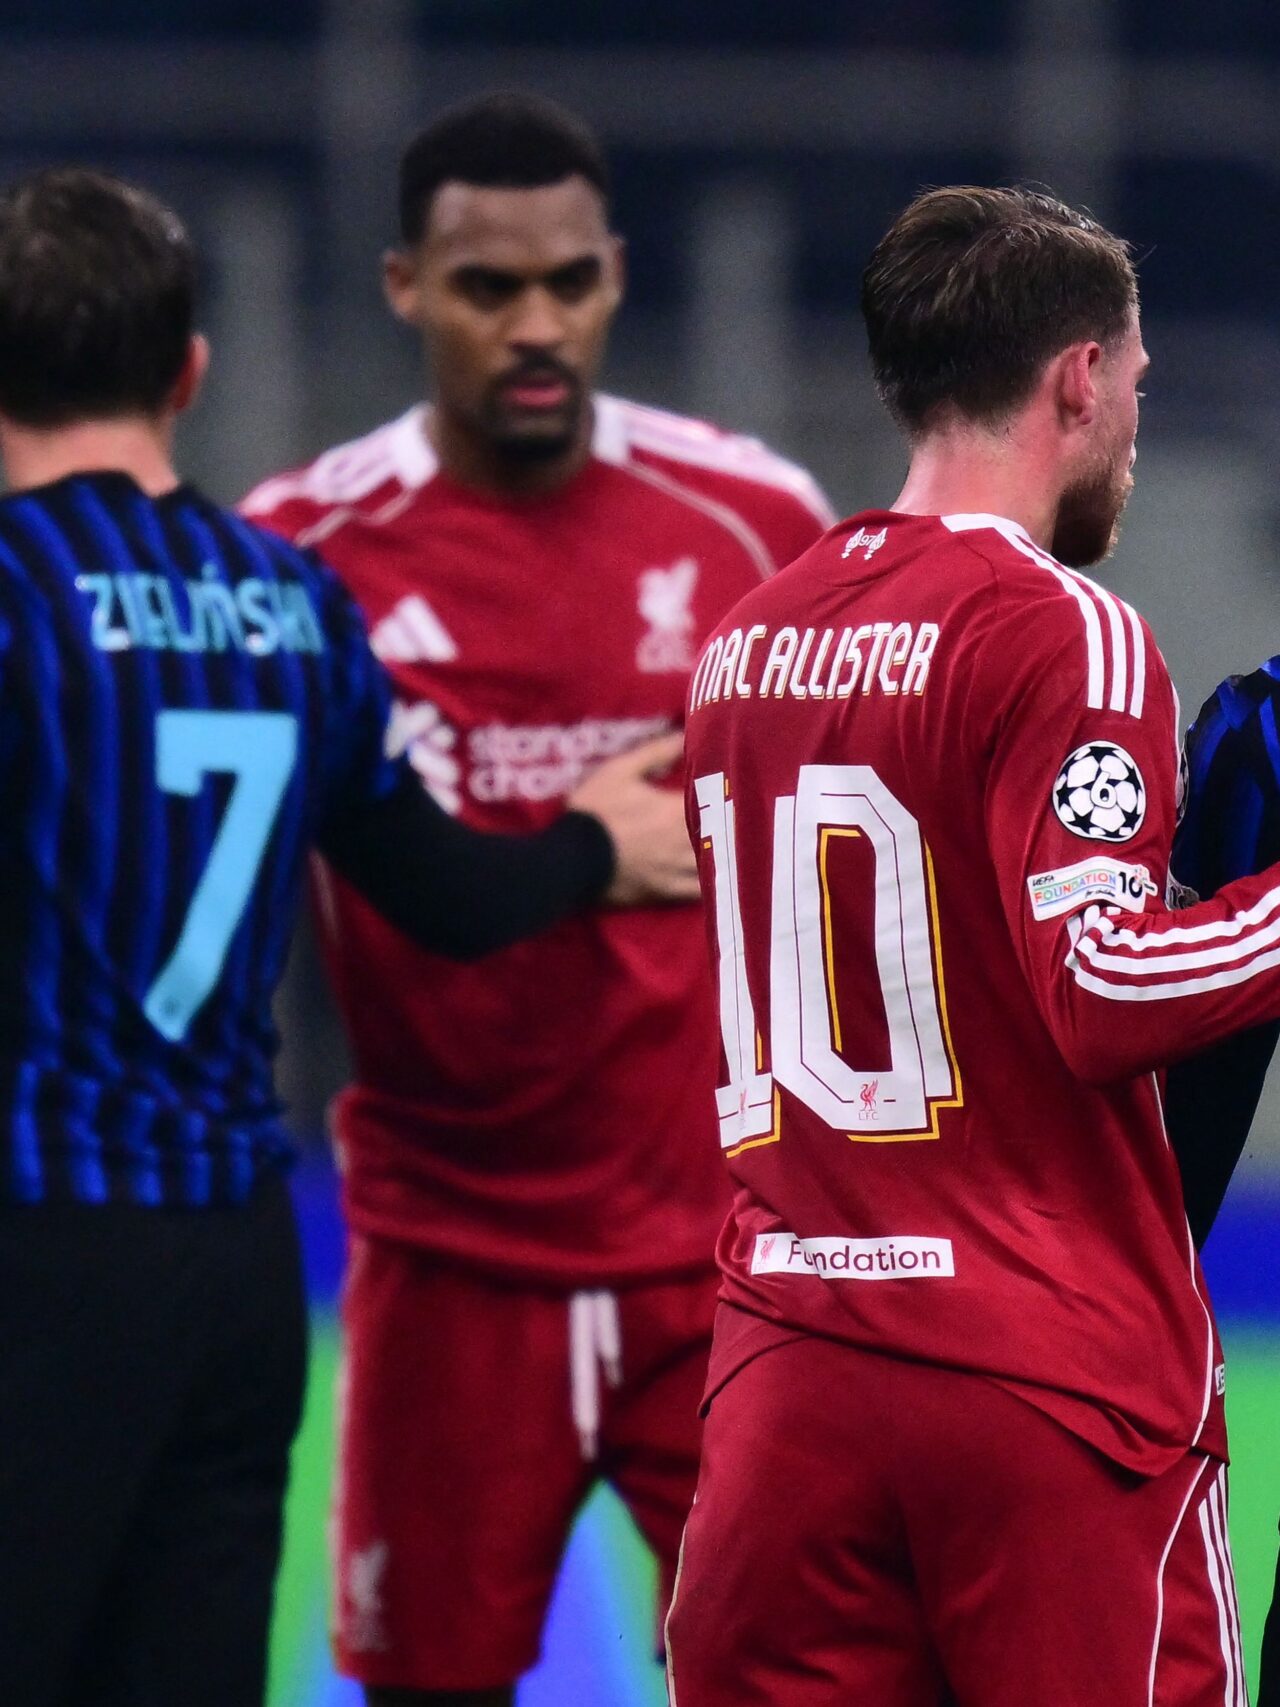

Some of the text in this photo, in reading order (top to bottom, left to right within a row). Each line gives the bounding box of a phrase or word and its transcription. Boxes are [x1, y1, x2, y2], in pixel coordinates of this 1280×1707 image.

[690, 624, 768, 716] MAC
[759, 621, 940, 700] ALLISTER
[143, 711, 297, 1042] 7
[694, 764, 964, 1158] 10
[1034, 872, 1117, 903] FOUNDATION
